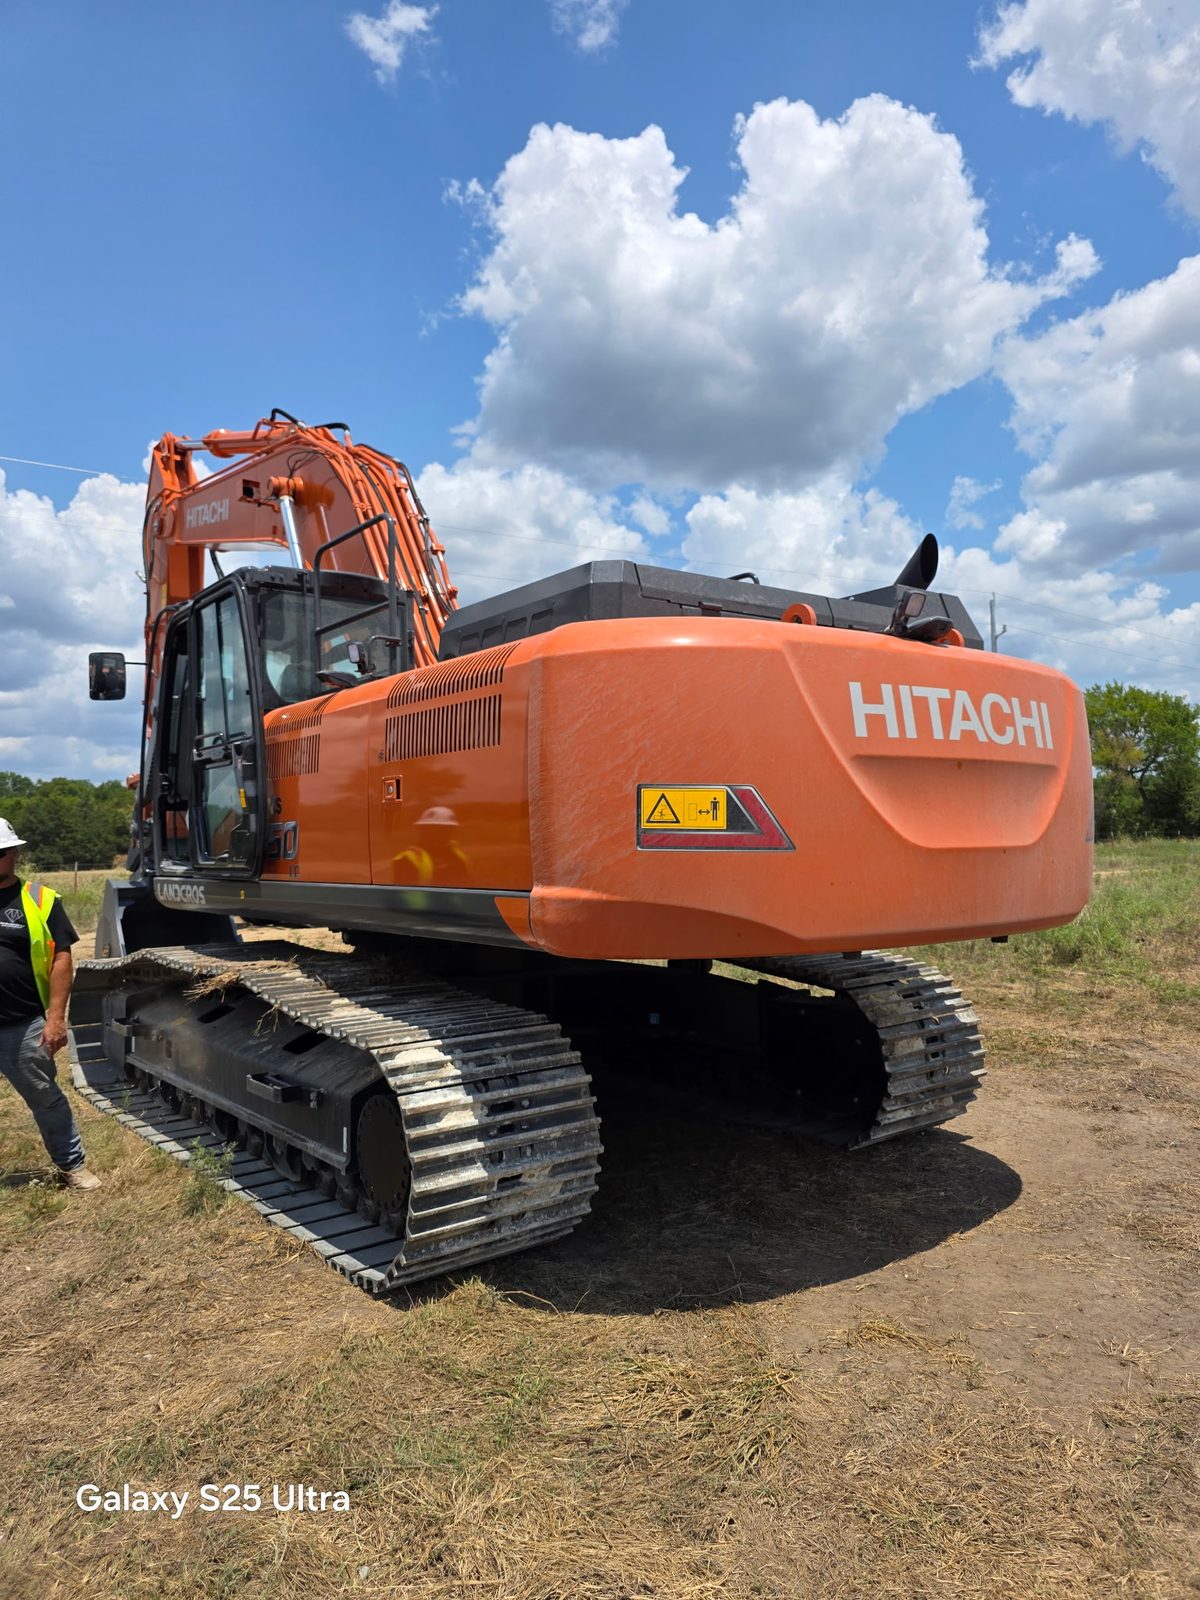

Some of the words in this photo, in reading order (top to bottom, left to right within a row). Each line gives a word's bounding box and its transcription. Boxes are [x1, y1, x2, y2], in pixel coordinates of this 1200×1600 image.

[186, 498, 230, 529] HITACHI
[848, 681, 1054, 750] HITACHI
[156, 883, 206, 905] LANDCROS
